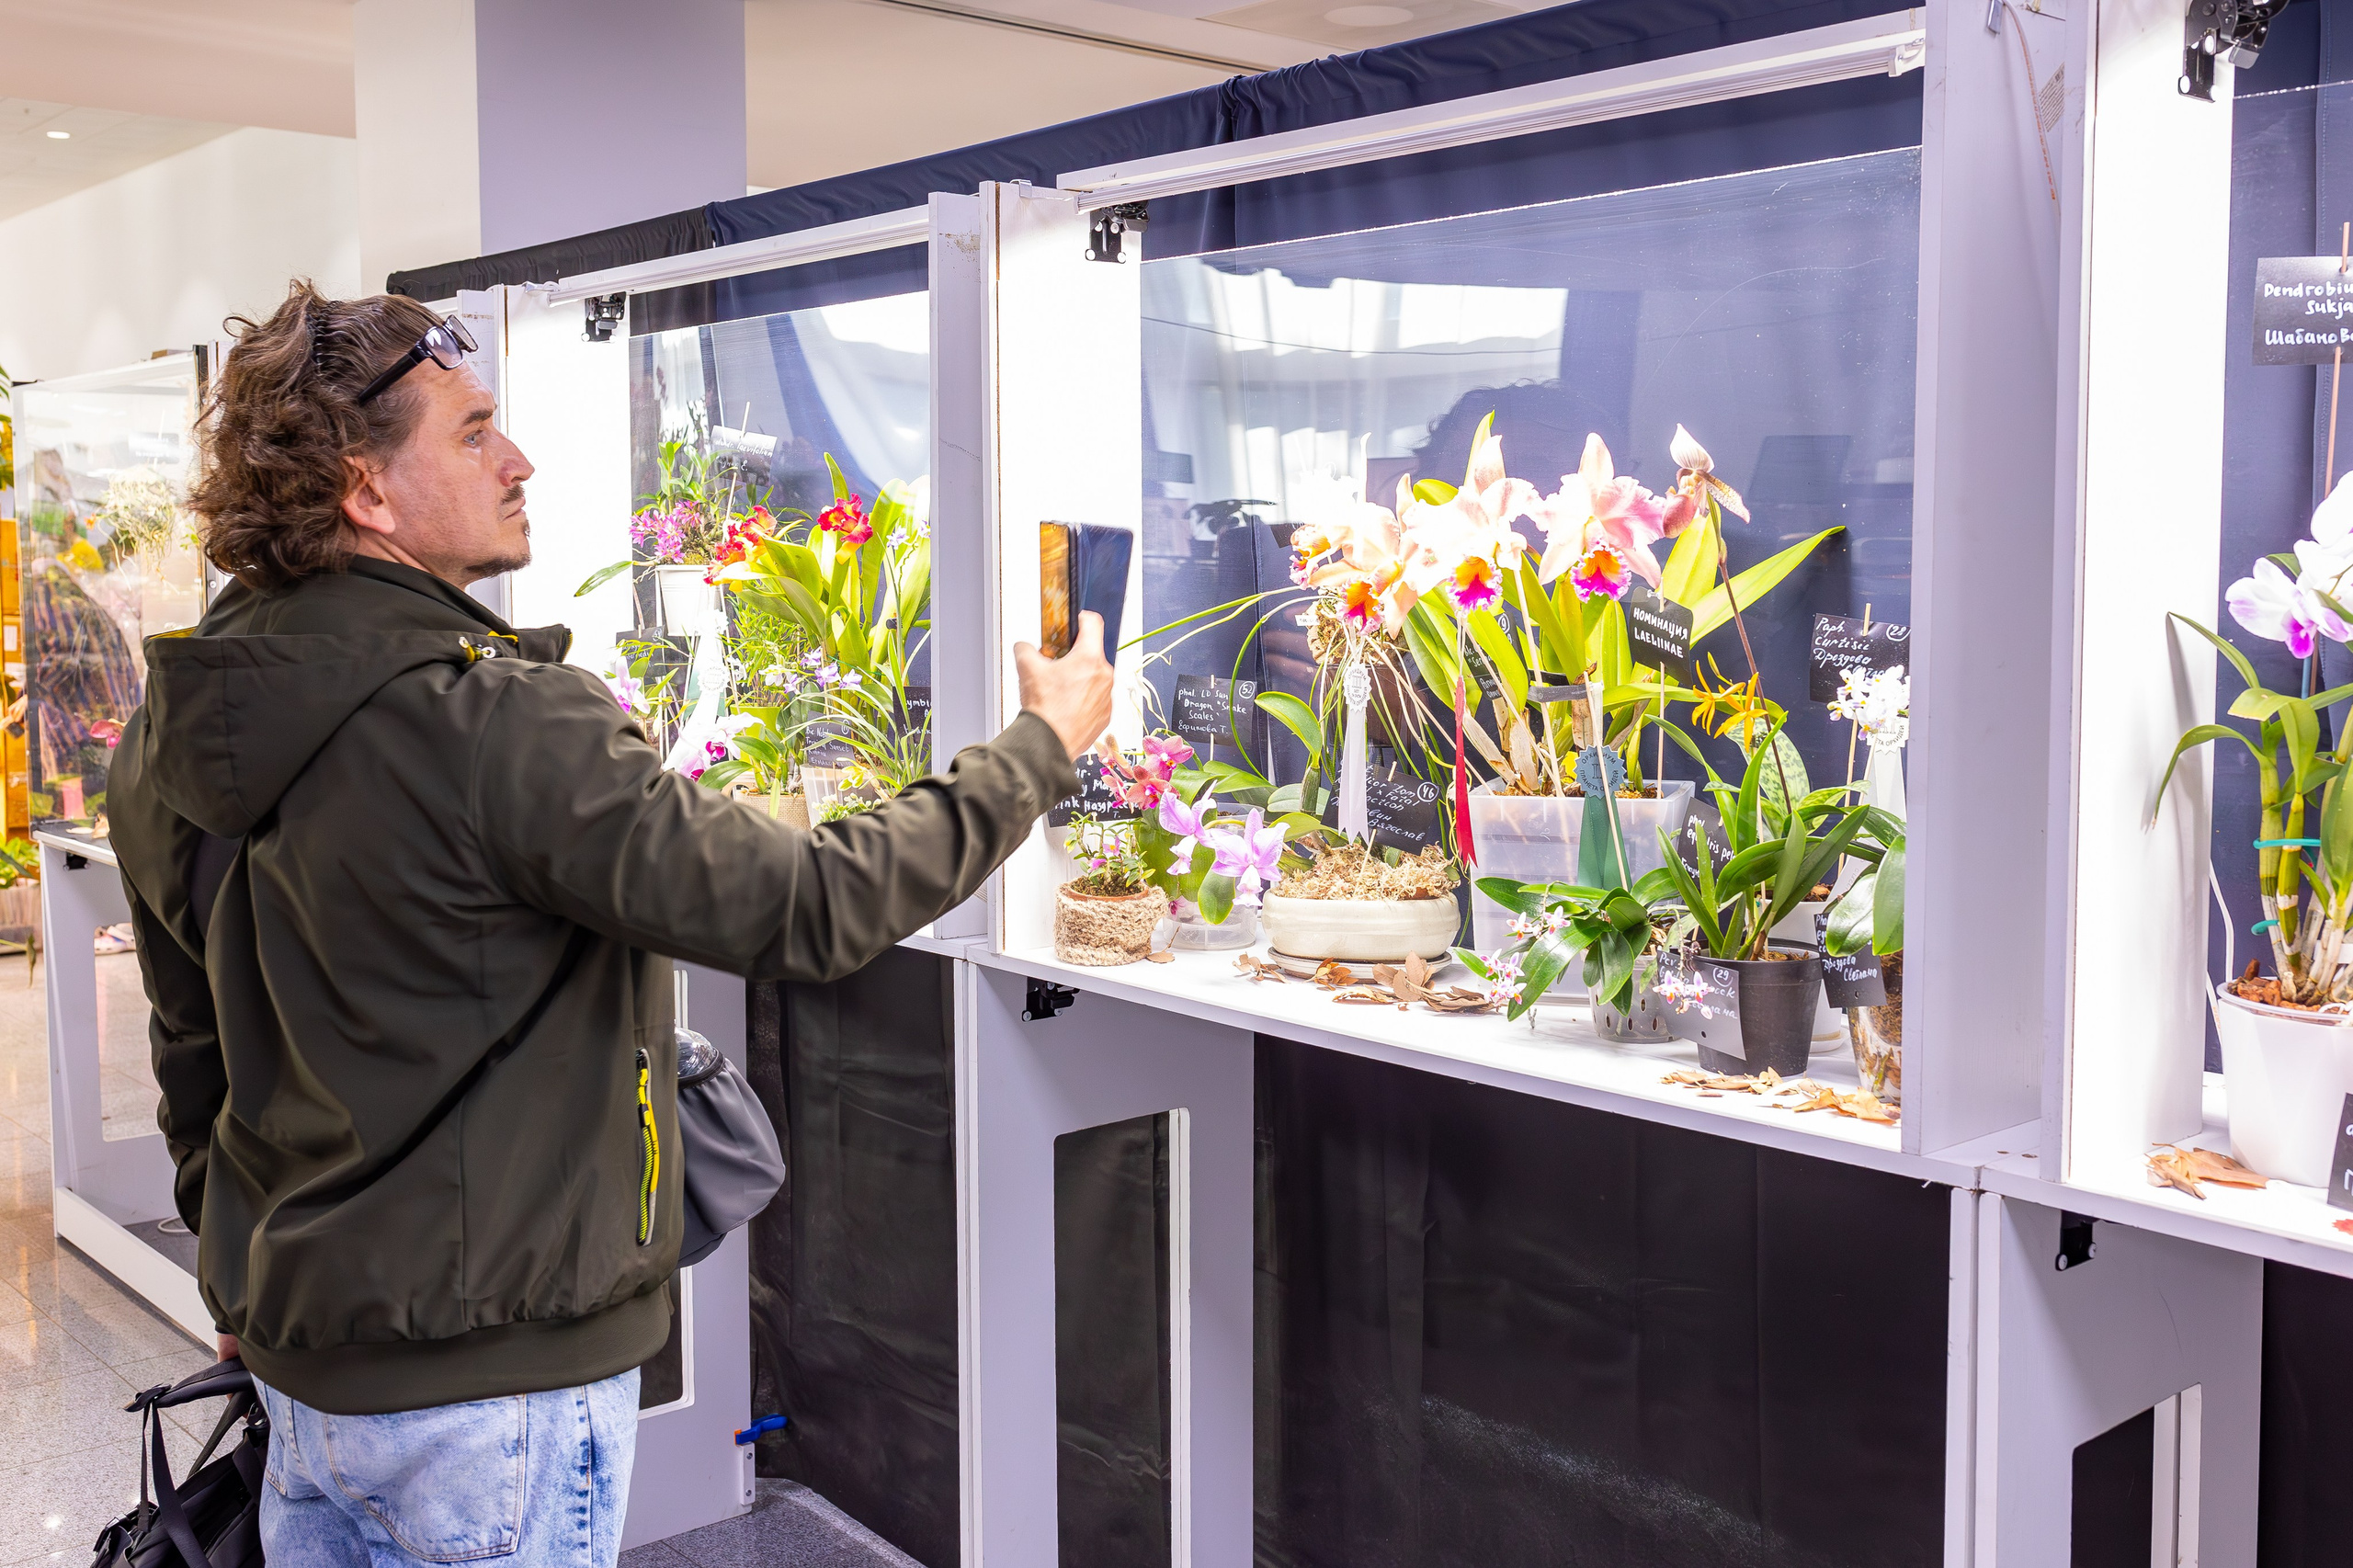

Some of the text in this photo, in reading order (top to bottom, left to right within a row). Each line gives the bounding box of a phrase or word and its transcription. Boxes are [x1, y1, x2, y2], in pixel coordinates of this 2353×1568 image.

[1633, 607, 1688, 640] НОМИНАЦИЯ
[1816, 618, 1845, 638] Paph.
[1634, 627, 1684, 658] LAELIINAE
[1201, 689, 1211, 698] LD
[1184, 699, 1213, 710] Dragon
[1581, 752, 1617, 764] ОРХИИУМ
[1580, 769, 1598, 791] ПЛАНЕТА
